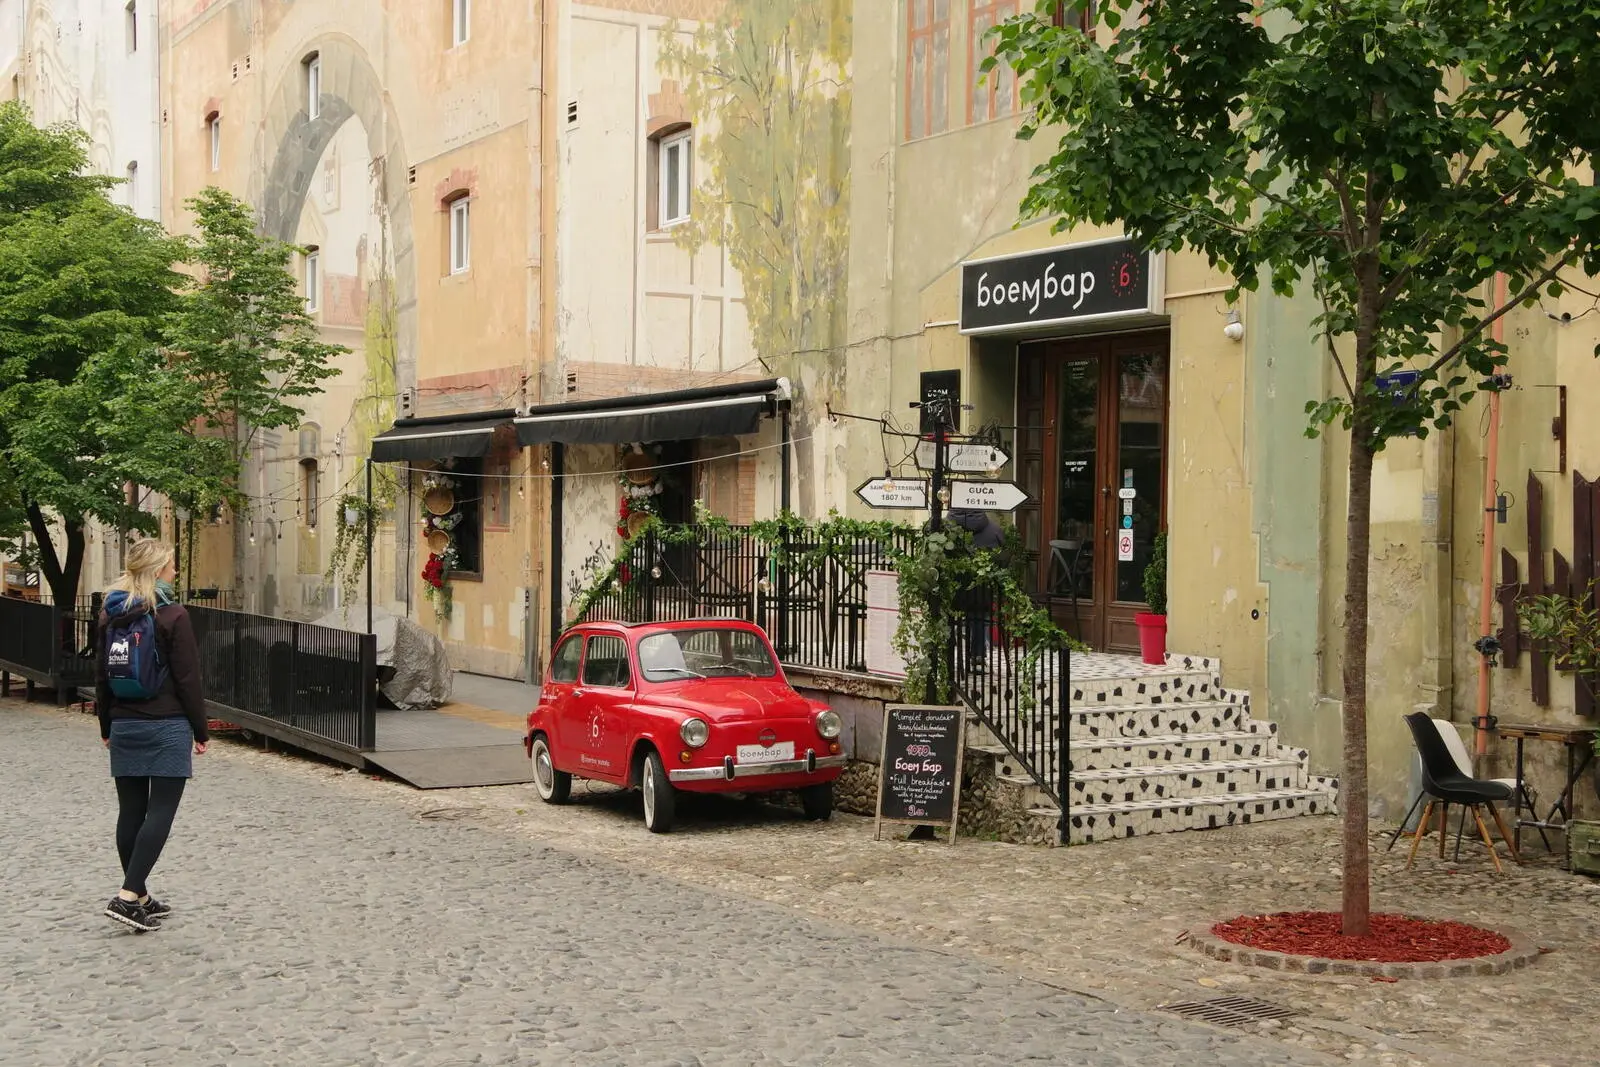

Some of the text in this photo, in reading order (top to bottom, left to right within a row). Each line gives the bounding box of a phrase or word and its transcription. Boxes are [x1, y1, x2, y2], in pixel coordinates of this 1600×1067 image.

[977, 262, 1095, 315] боембар
[893, 774, 945, 786] Full breakfast
